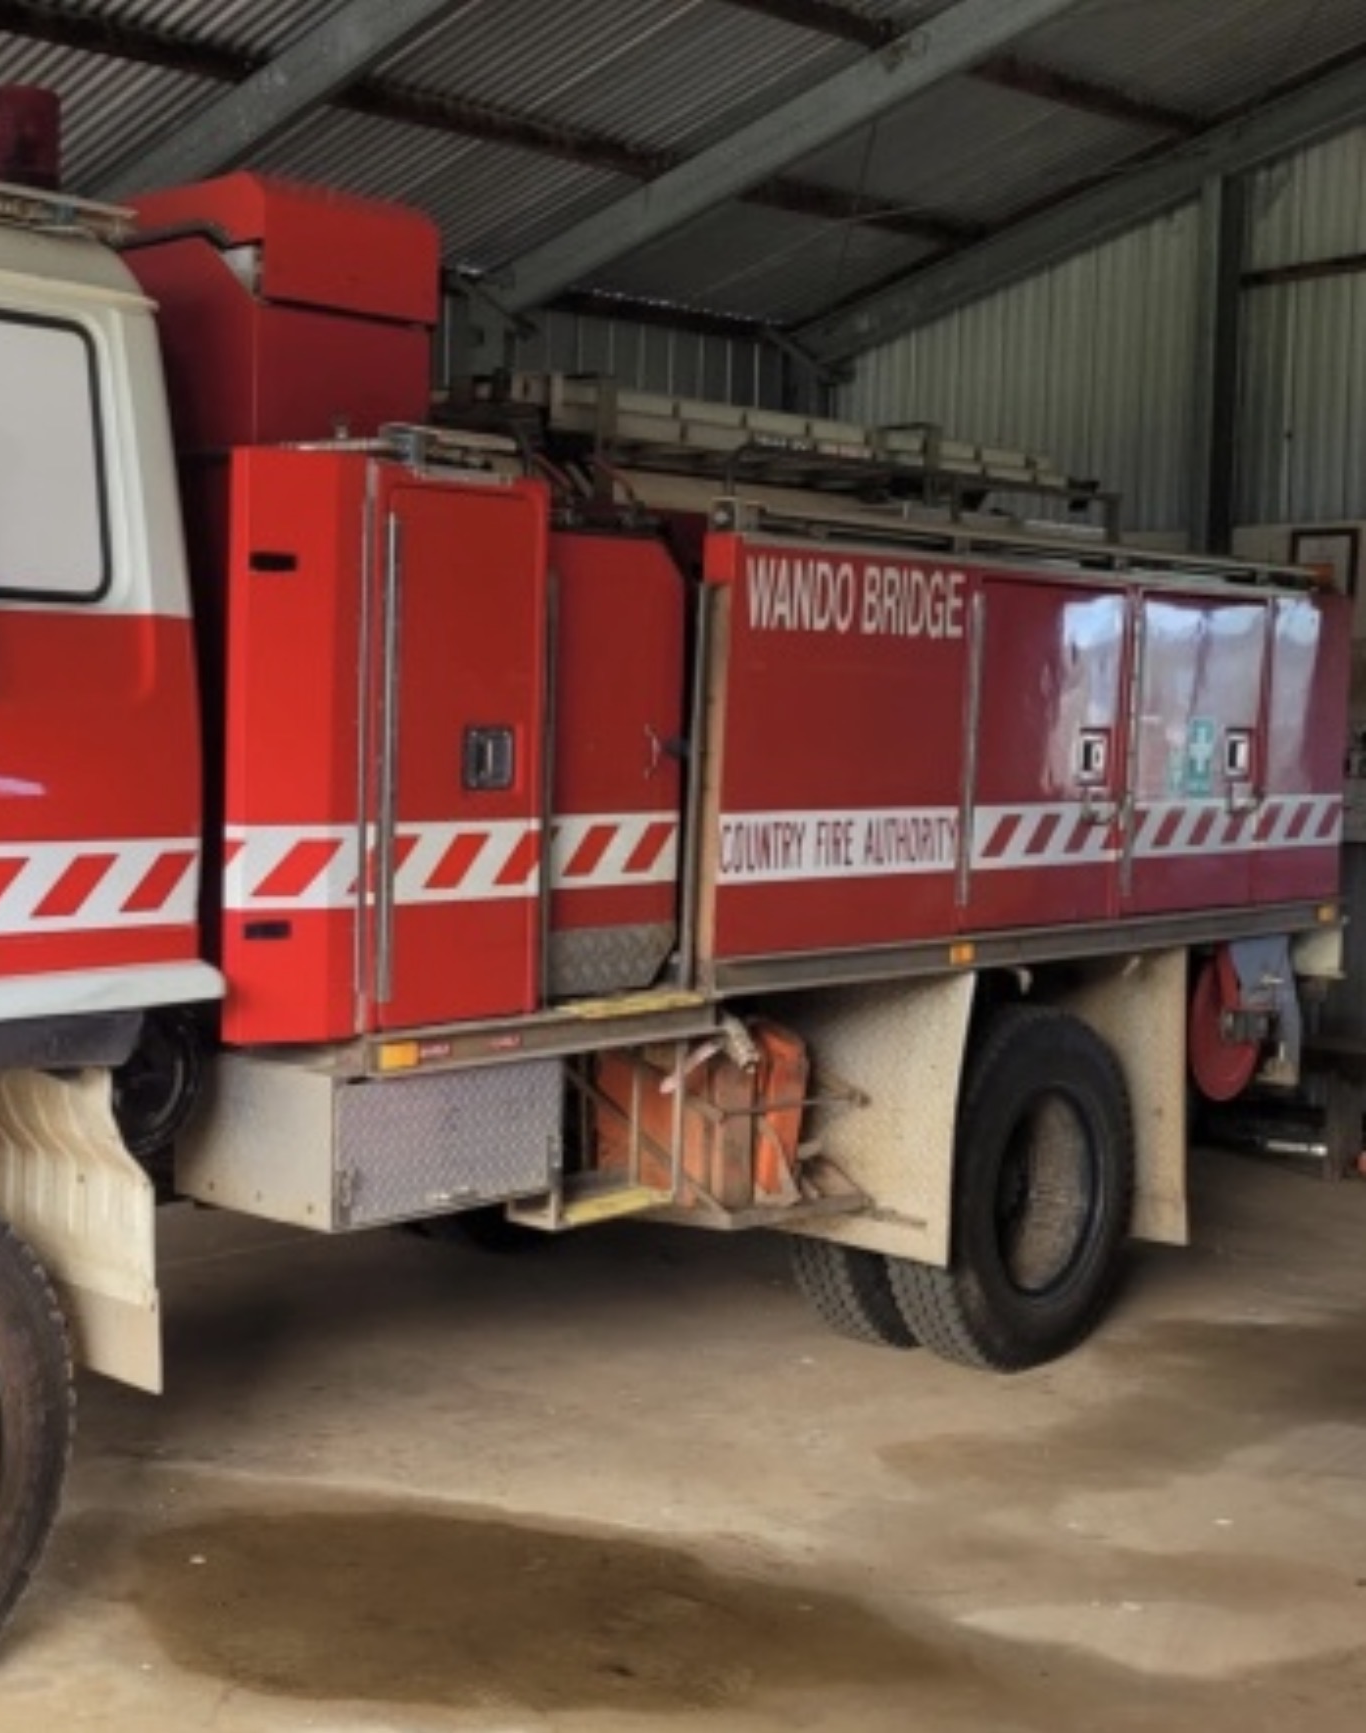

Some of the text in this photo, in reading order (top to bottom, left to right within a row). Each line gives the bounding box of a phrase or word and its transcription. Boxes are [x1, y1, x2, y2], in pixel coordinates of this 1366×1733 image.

[746, 556, 965, 638] WANDO BRIDGE
[719, 816, 959, 873] COUNTRY FIRE AUTHORITY
